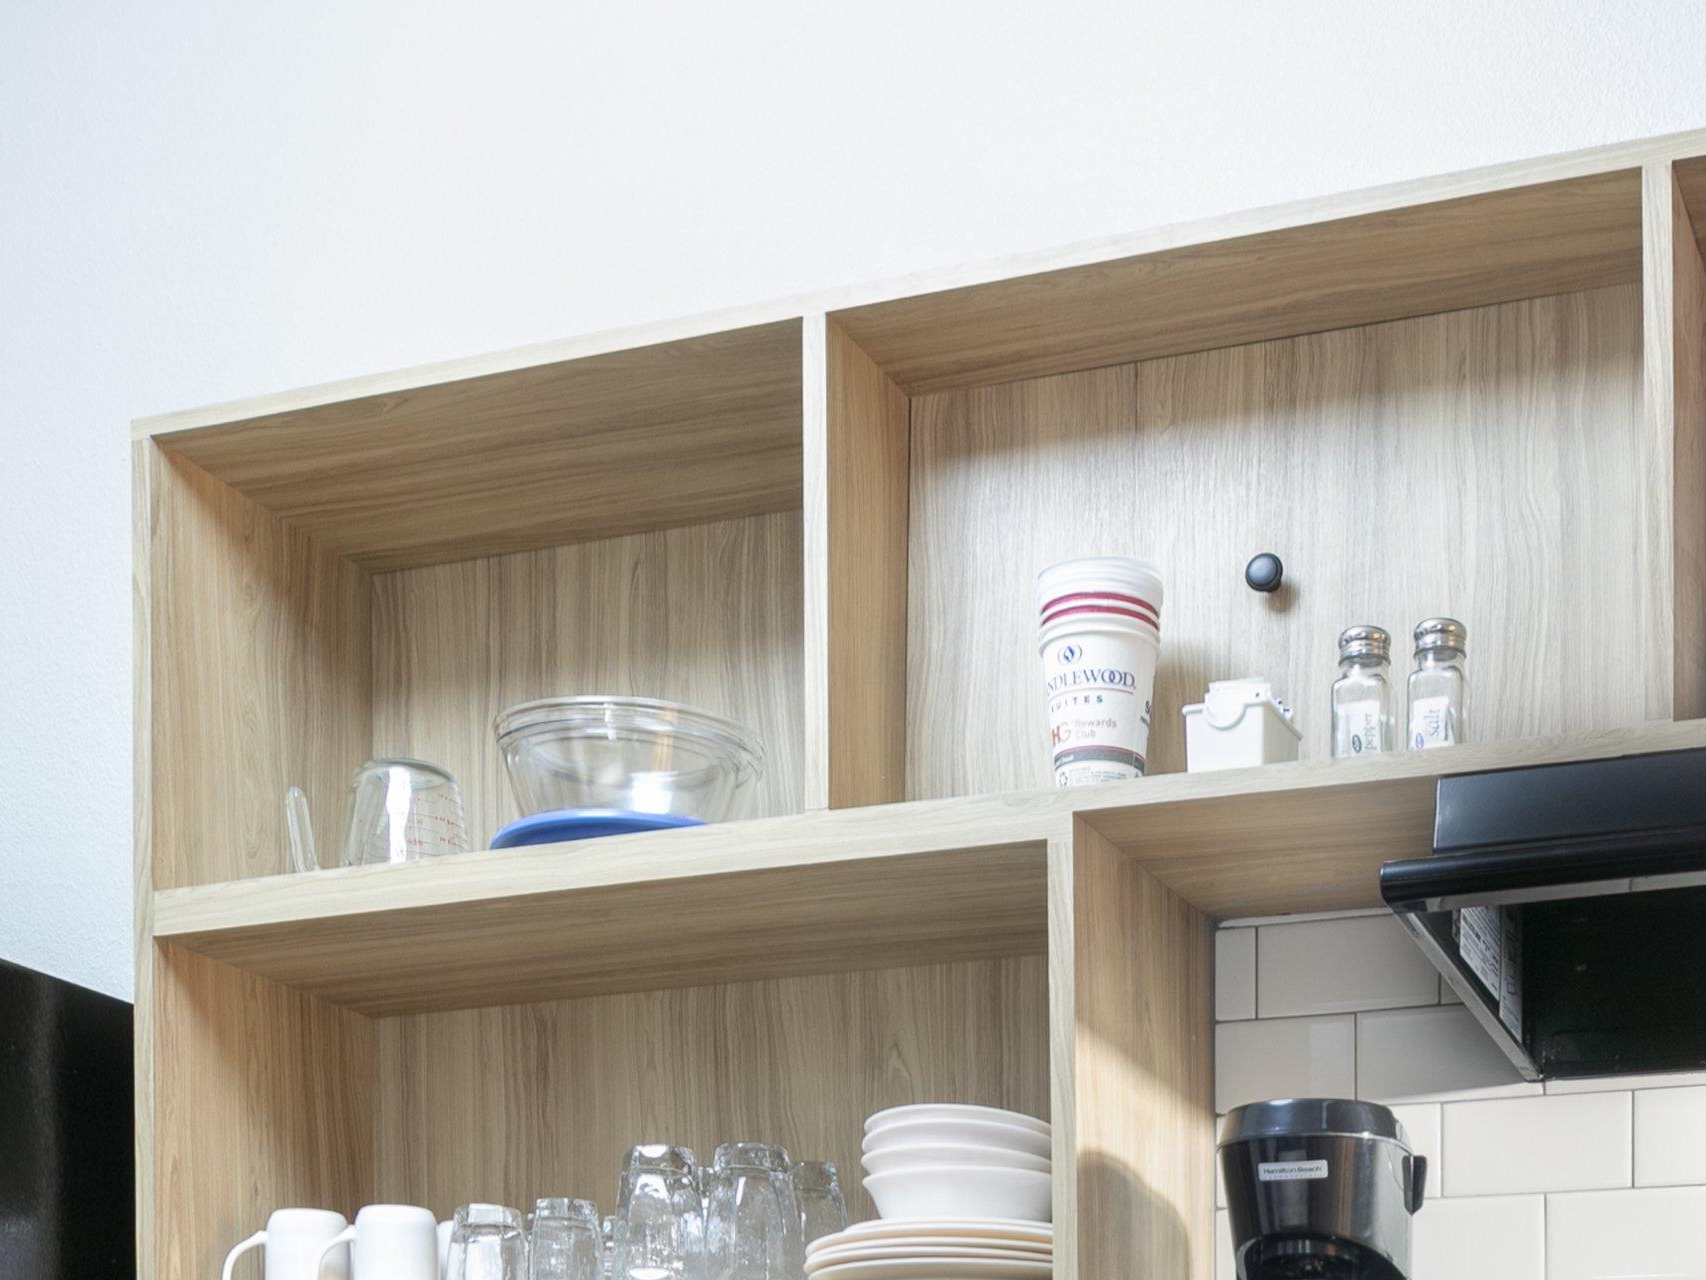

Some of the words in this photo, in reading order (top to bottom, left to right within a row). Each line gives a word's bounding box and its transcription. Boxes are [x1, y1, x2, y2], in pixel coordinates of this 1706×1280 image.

[1074, 717, 1117, 728] Rewards
[1423, 708, 1441, 737] salt
[1074, 729, 1097, 739] Club
[1263, 1166, 1296, 1175] Hamilton
[1297, 1165, 1323, 1173] Beach
